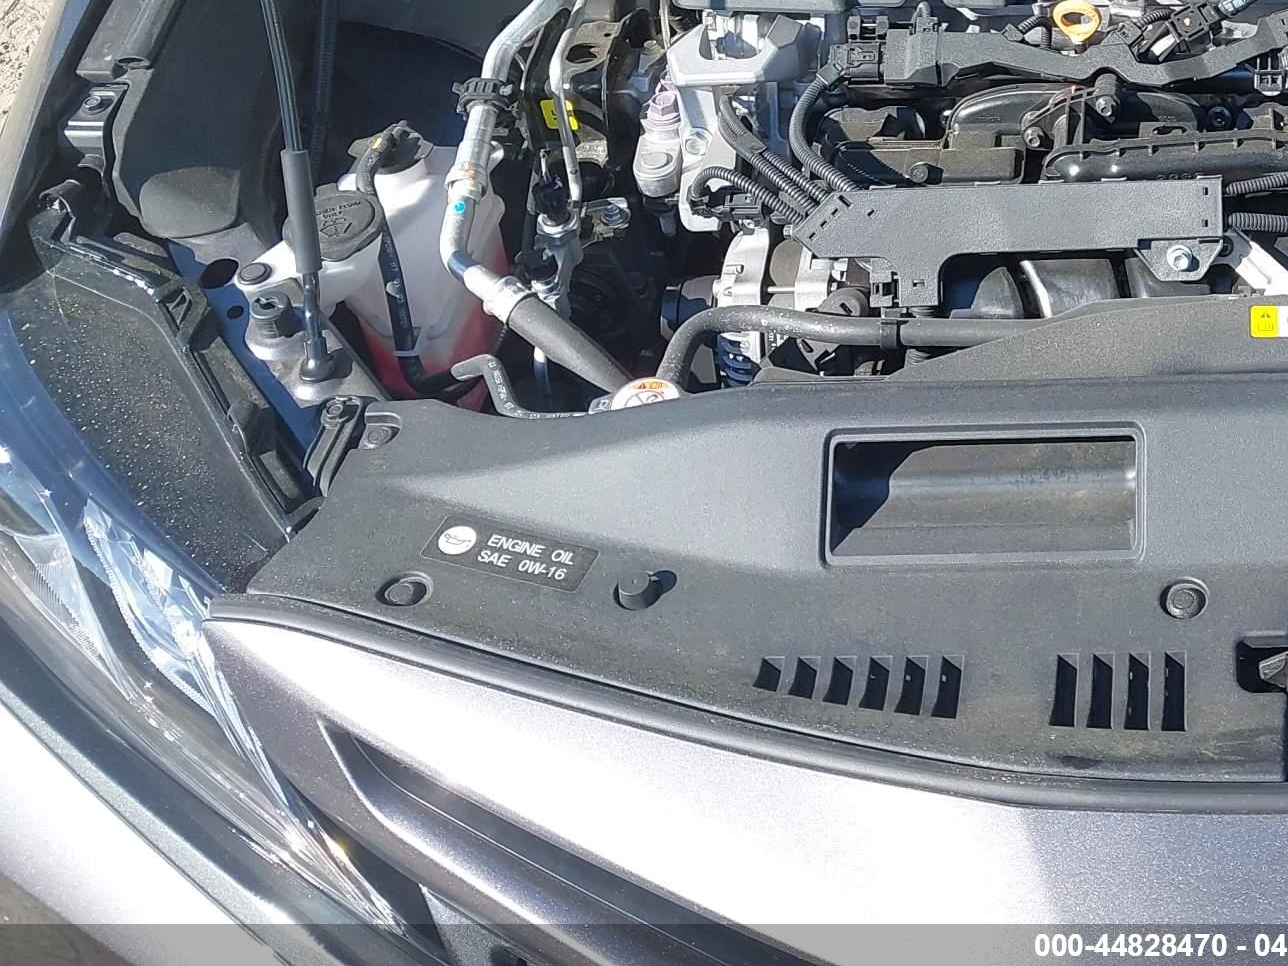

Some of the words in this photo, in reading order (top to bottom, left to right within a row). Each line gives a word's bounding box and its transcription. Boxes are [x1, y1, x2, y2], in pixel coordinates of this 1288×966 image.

[477, 550, 512, 567] SAE
[518, 559, 567, 580] 0W-16
[487, 534, 546, 558] ENGINE
[551, 549, 575, 566] OIL
